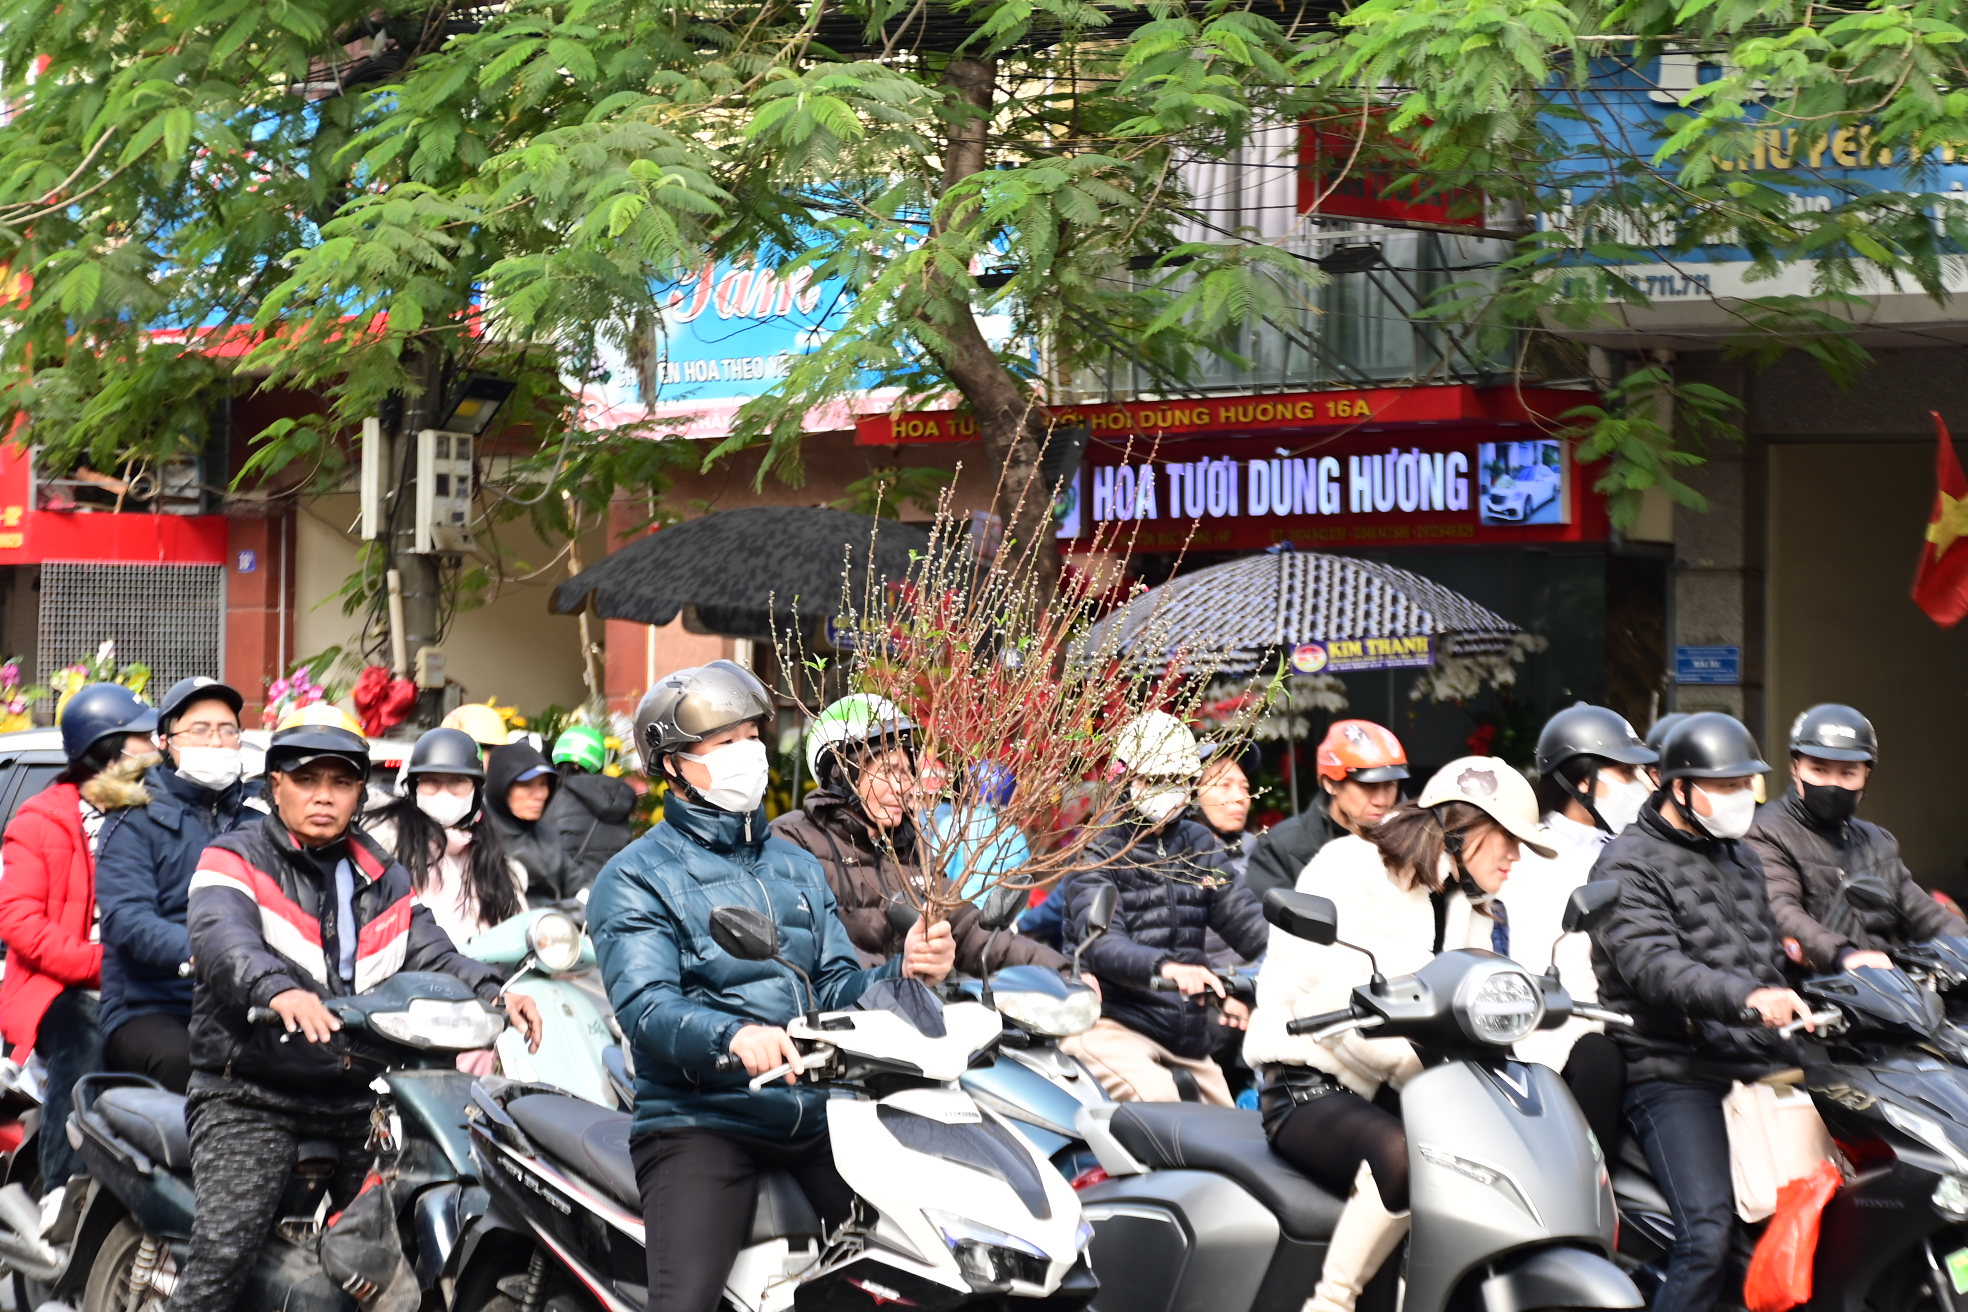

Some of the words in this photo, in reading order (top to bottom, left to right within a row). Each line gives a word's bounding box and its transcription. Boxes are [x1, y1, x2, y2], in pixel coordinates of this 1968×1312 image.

[617, 350, 681, 388] CHÊN
[684, 358, 720, 384] HOA
[720, 356, 765, 382] THEO
[890, 420, 940, 438] HOA
[1140, 405, 1210, 428] DŨNG
[1219, 402, 1314, 424] HƯƠNG
[1326, 399, 1372, 418] 16A
[1093, 464, 1158, 521] HOA
[1166, 455, 1238, 519] TƯƠI
[1248, 447, 1341, 516] DŨNG
[1349, 447, 1469, 513] HƯƠNG
[1327, 639, 1363, 658] KIM
[1365, 636, 1429, 656] THANH
[1854, 1197, 1905, 1209] HONDA
